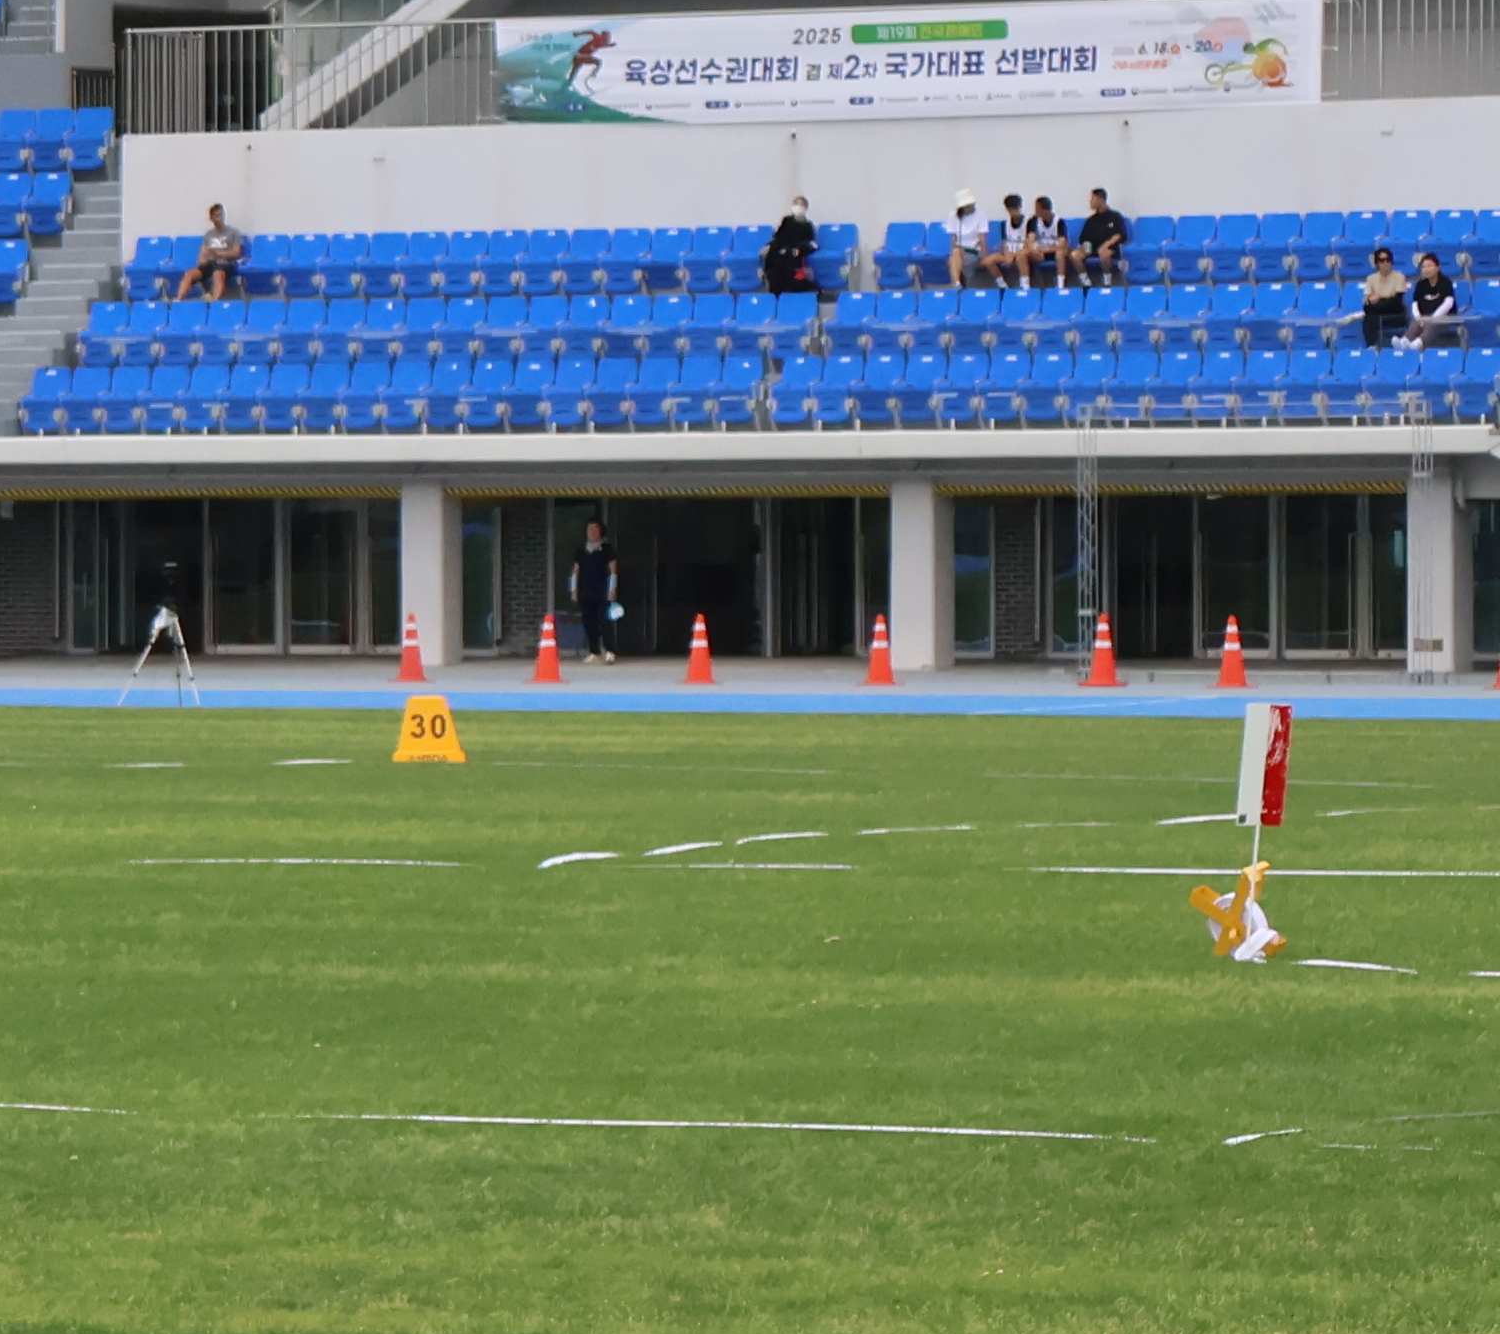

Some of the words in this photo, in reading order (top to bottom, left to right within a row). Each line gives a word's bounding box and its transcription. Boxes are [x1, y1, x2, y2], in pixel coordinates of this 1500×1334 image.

[792, 27, 842, 45] 2025
[625, 56, 799, 86] 육상선수권대회
[827, 54, 878, 80] 제2차
[885, 49, 986, 79] 국가대표
[994, 45, 1098, 75] 선발대회
[410, 714, 447, 739] 30
